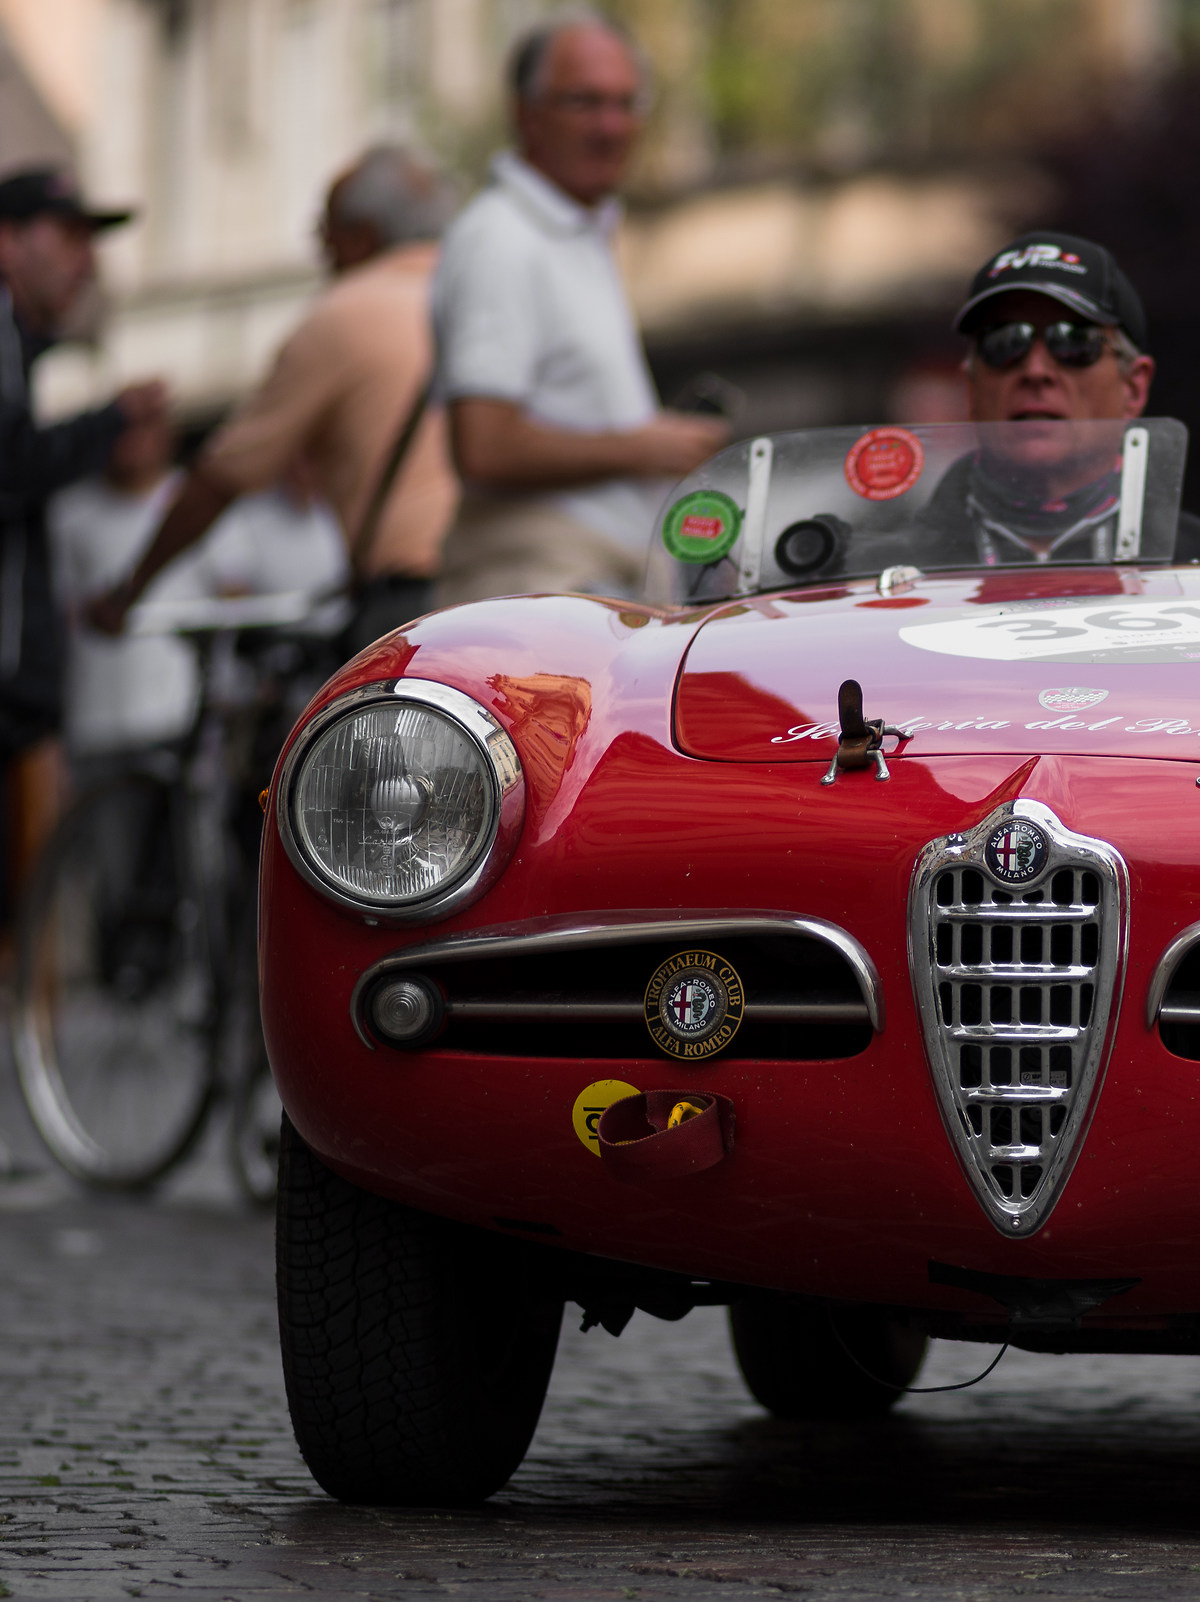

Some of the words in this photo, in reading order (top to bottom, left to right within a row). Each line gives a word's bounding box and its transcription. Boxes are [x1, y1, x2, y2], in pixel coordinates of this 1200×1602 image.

[1024, 714, 1124, 731] del
[996, 866, 1035, 879] MILANO
[647, 953, 717, 1009] TROPHAEUM
[719, 967, 741, 1006] CLUB
[674, 1018, 707, 1031] MILANO
[652, 1025, 680, 1054] ALFA
[684, 1024, 732, 1057] ROMEO
